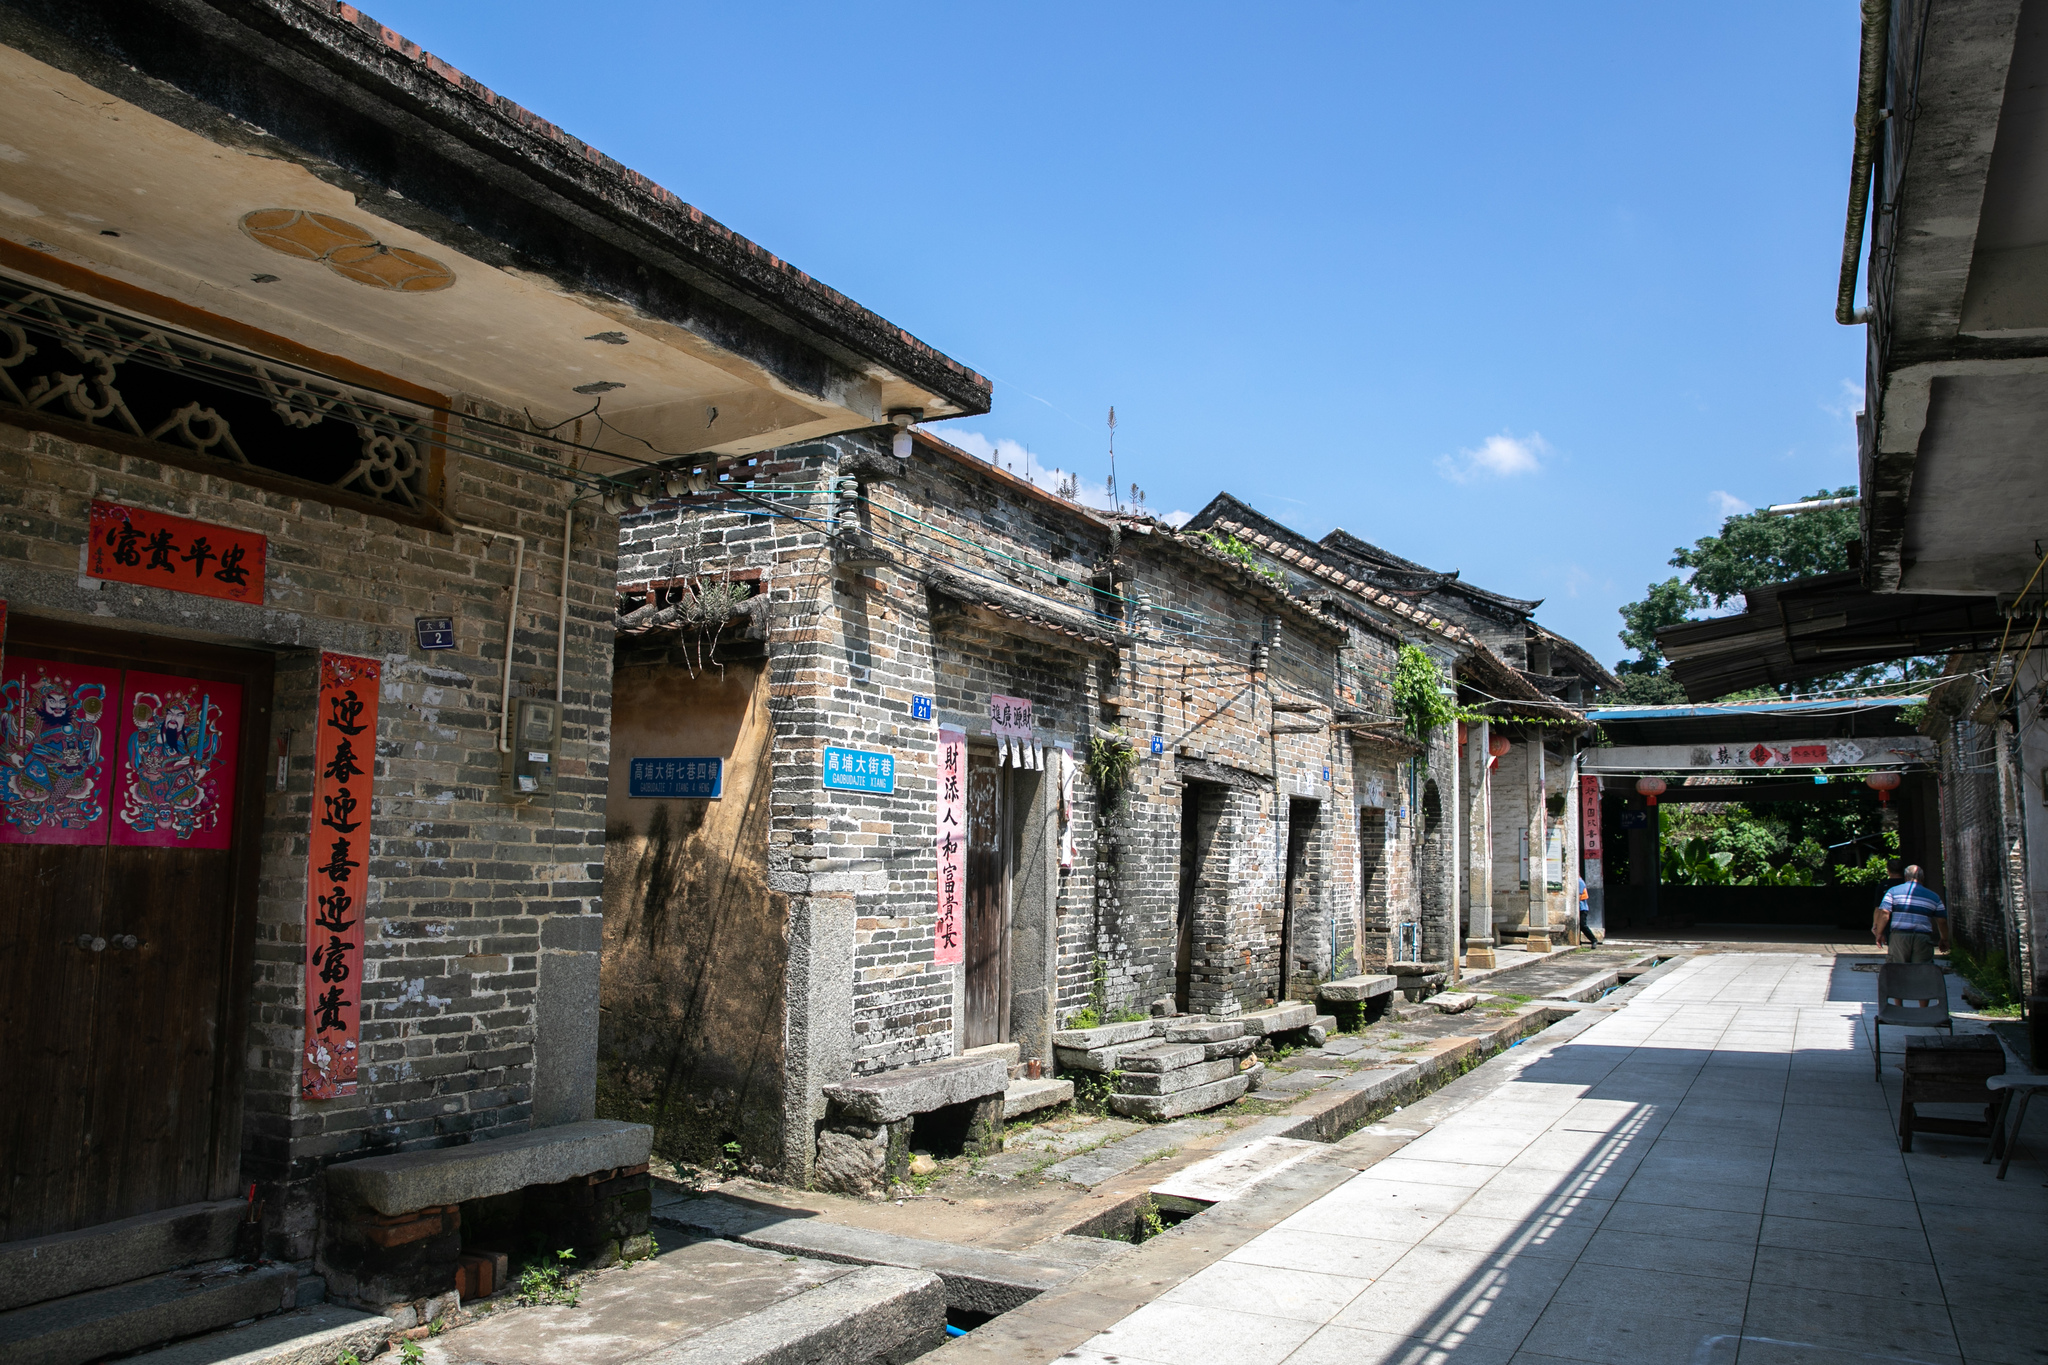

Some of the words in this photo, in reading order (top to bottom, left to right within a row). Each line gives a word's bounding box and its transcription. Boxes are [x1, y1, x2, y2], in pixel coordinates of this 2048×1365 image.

[105, 520, 250, 587] 富貴平安
[434, 632, 443, 644] 2
[917, 705, 927, 718] 21
[634, 762, 718, 780] 高埔大街七巷四横
[828, 751, 892, 777] 高埔大街巷
[832, 773, 866, 787] GAOBUDAJIE
[870, 777, 887, 788] XIANG
[311, 689, 369, 1035] 迎春迎喜迎富貴
